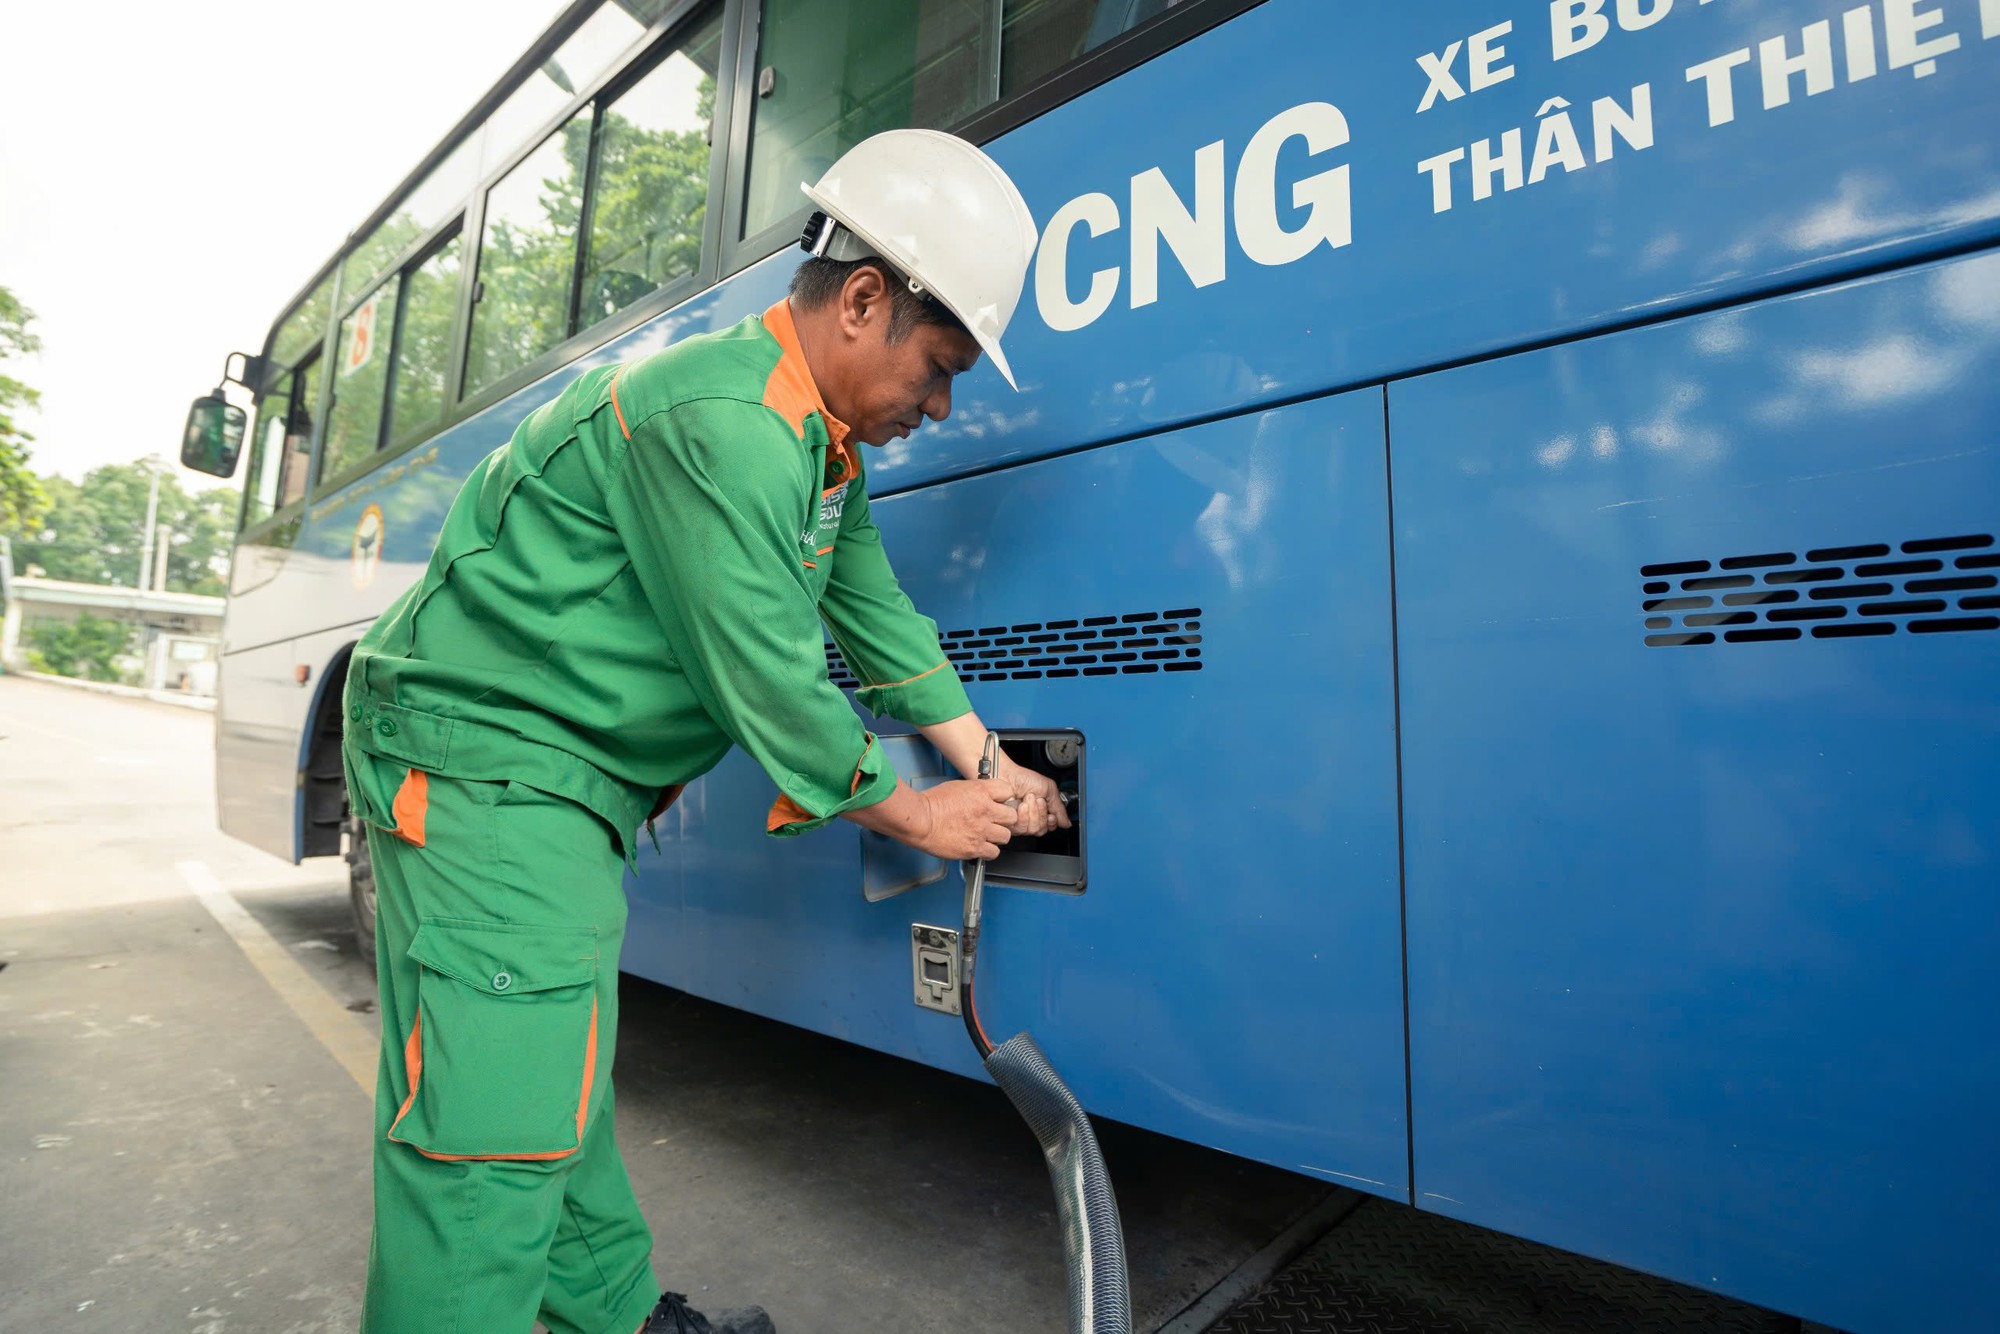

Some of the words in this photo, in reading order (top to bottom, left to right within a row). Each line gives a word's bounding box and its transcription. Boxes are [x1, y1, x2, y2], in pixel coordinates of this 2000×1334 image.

[1416, 20, 1515, 114] XE
[1417, 83, 1655, 214] THÂN
[1035, 102, 1352, 332] CNG
